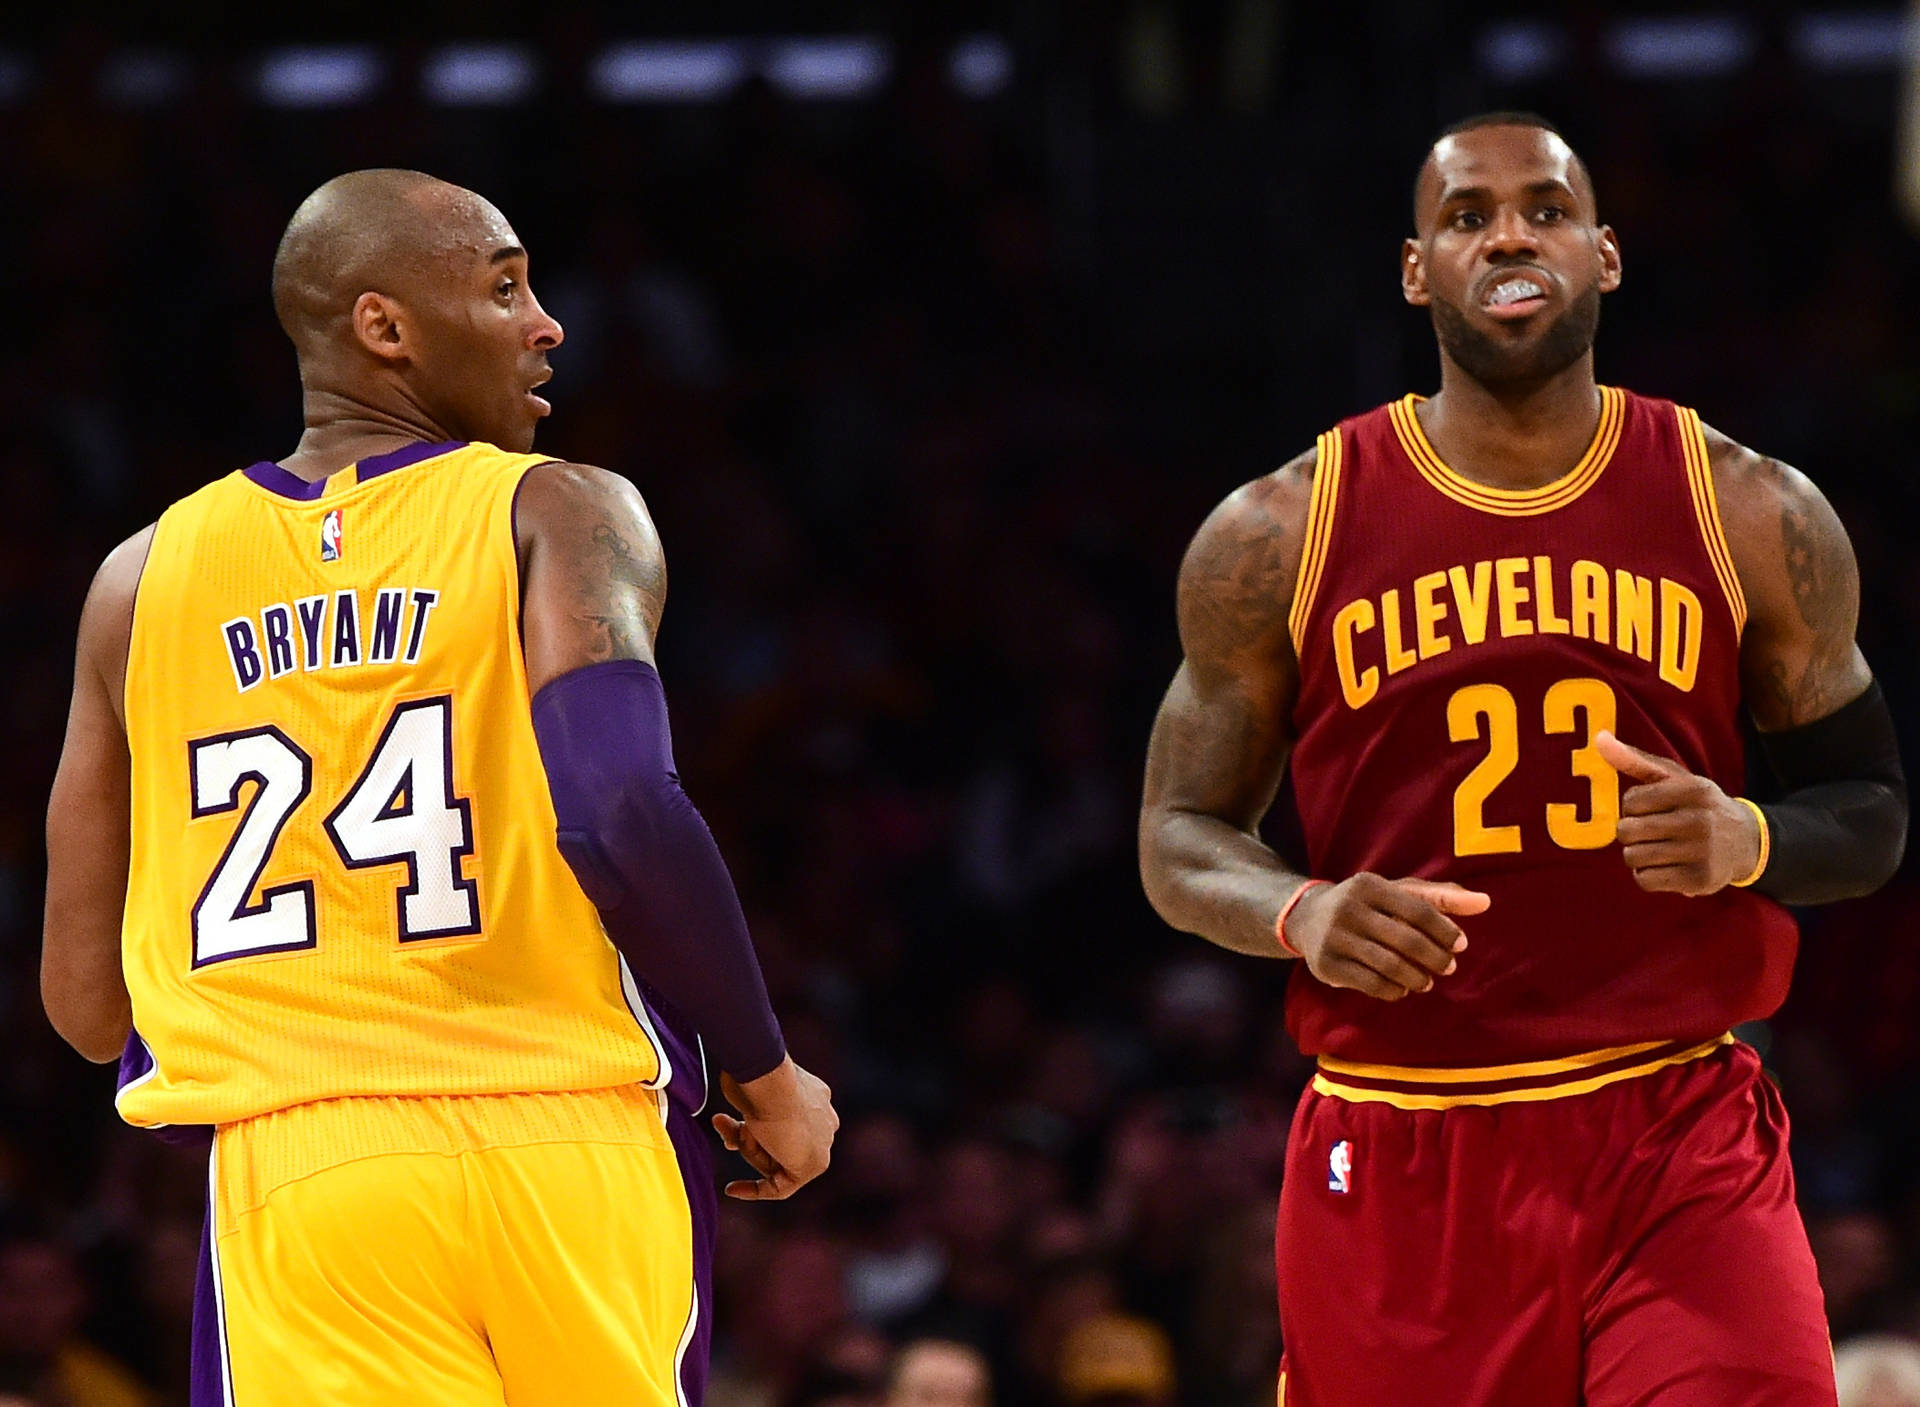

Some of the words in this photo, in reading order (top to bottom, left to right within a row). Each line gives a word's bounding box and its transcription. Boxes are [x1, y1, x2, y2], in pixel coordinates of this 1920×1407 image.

[221, 588, 439, 693] BRYANT
[1332, 556, 1703, 710] CLEVELAND
[188, 694, 482, 971] 24
[1447, 678, 1620, 857] 23
